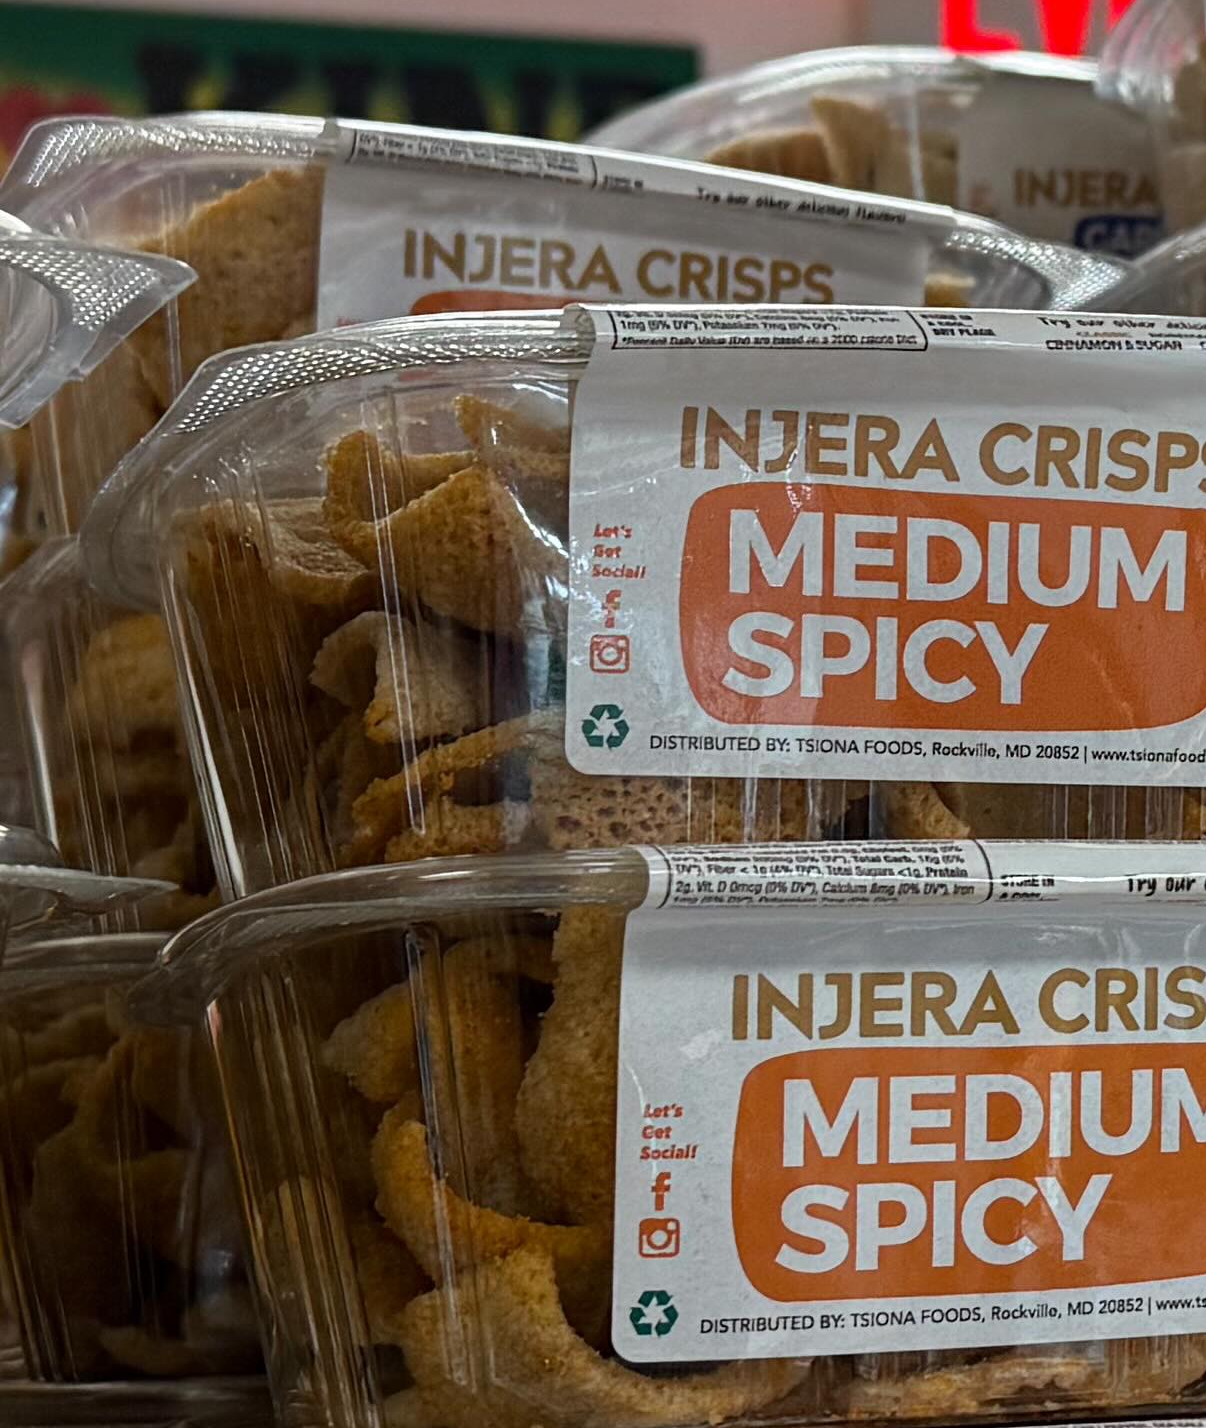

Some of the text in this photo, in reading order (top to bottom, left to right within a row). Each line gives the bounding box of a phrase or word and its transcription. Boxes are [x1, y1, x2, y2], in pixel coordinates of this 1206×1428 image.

[1014, 169, 1160, 207] INJERA
[403, 227, 837, 306] INJERA CRISPS
[679, 404, 961, 483] INJERA
[728, 508, 1188, 613] MEDIUM
[721, 611, 1051, 706] SPICY
[649, 734, 761, 752] DISTRIBUTED
[765, 738, 790, 753] BY:
[795, 738, 859, 754] TSIONA
[864, 739, 927, 758] FOODS,
[931, 741, 1001, 760] Rockville,
[1005, 744, 1031, 759] MD
[1035, 744, 1080, 760] 20852
[1164, 877, 1196, 892] our
[730, 968, 1022, 1042] INJERA
[643, 1103, 684, 1119] Let's
[641, 1124, 673, 1140] Get
[639, 1143, 699, 1161] Social!
[774, 1173, 1114, 1274] SPICY
[700, 1315, 815, 1335] DISTRIBUTED
[819, 1313, 845, 1330] BY:
[850, 1311, 916, 1328] TSIONA
[921, 1306, 986, 1325] FOODS,
[991, 1302, 1063, 1321] Rockville,
[1067, 1301, 1094, 1317] MD
[1098, 1298, 1144, 1316] 20852
